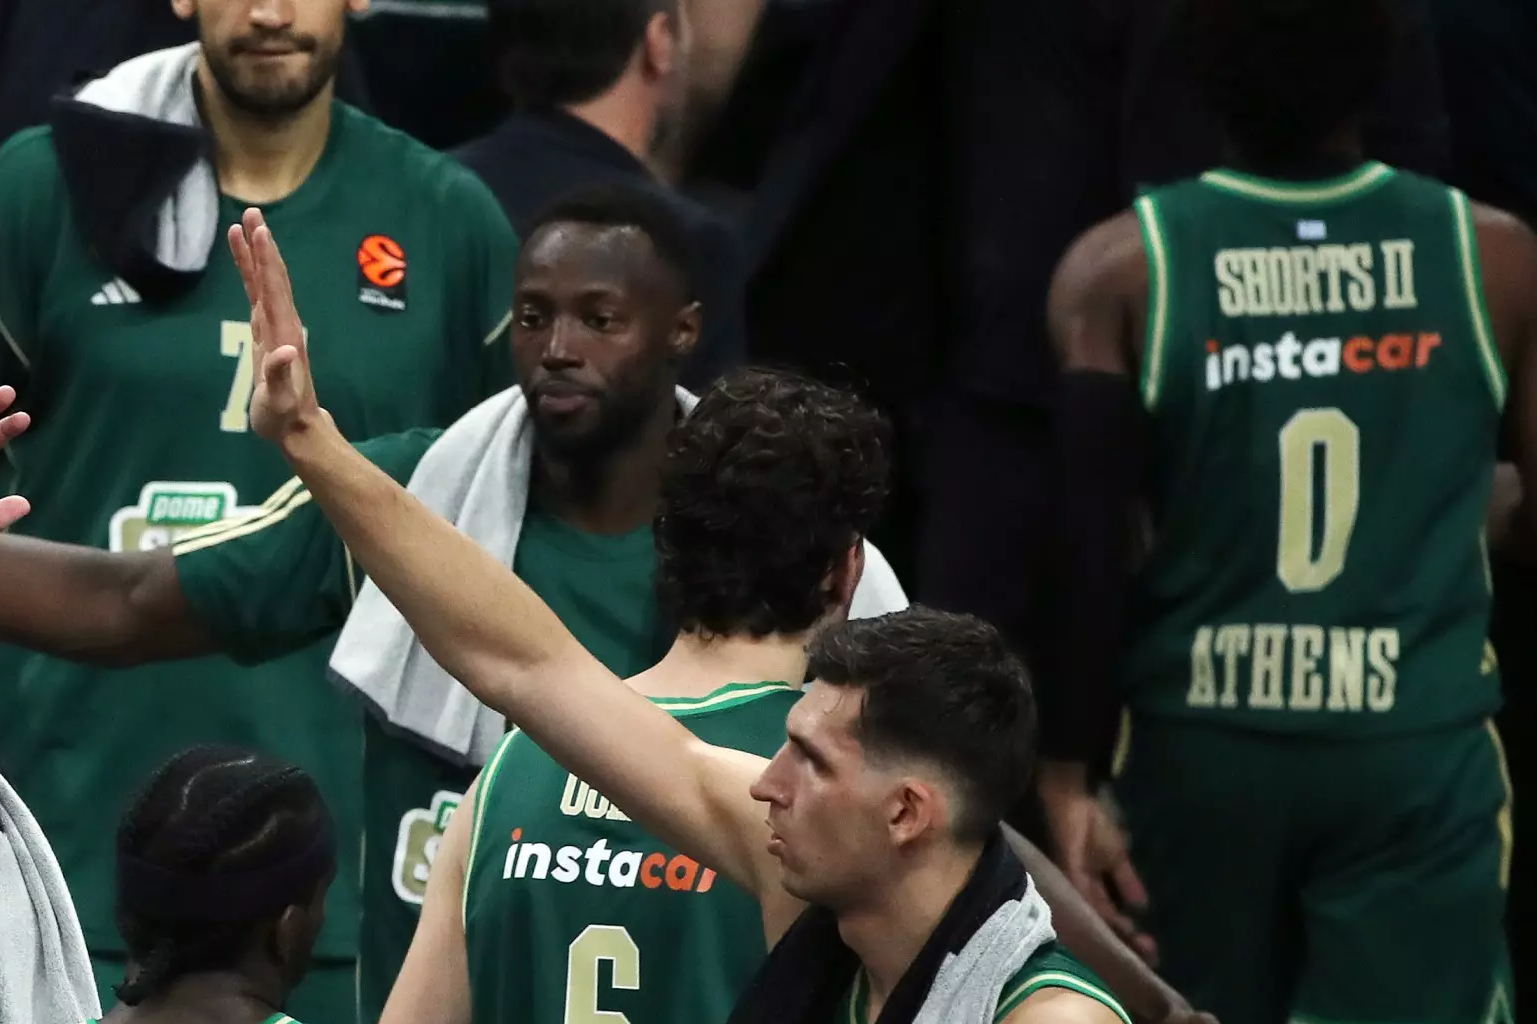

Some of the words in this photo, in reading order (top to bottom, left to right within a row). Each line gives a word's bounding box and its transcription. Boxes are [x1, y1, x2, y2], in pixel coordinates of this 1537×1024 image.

[1215, 243, 1375, 317] SHORTS
[1205, 331, 1442, 390] instacar
[1276, 406, 1361, 593] 0
[1185, 622, 1400, 713] ATHENS
